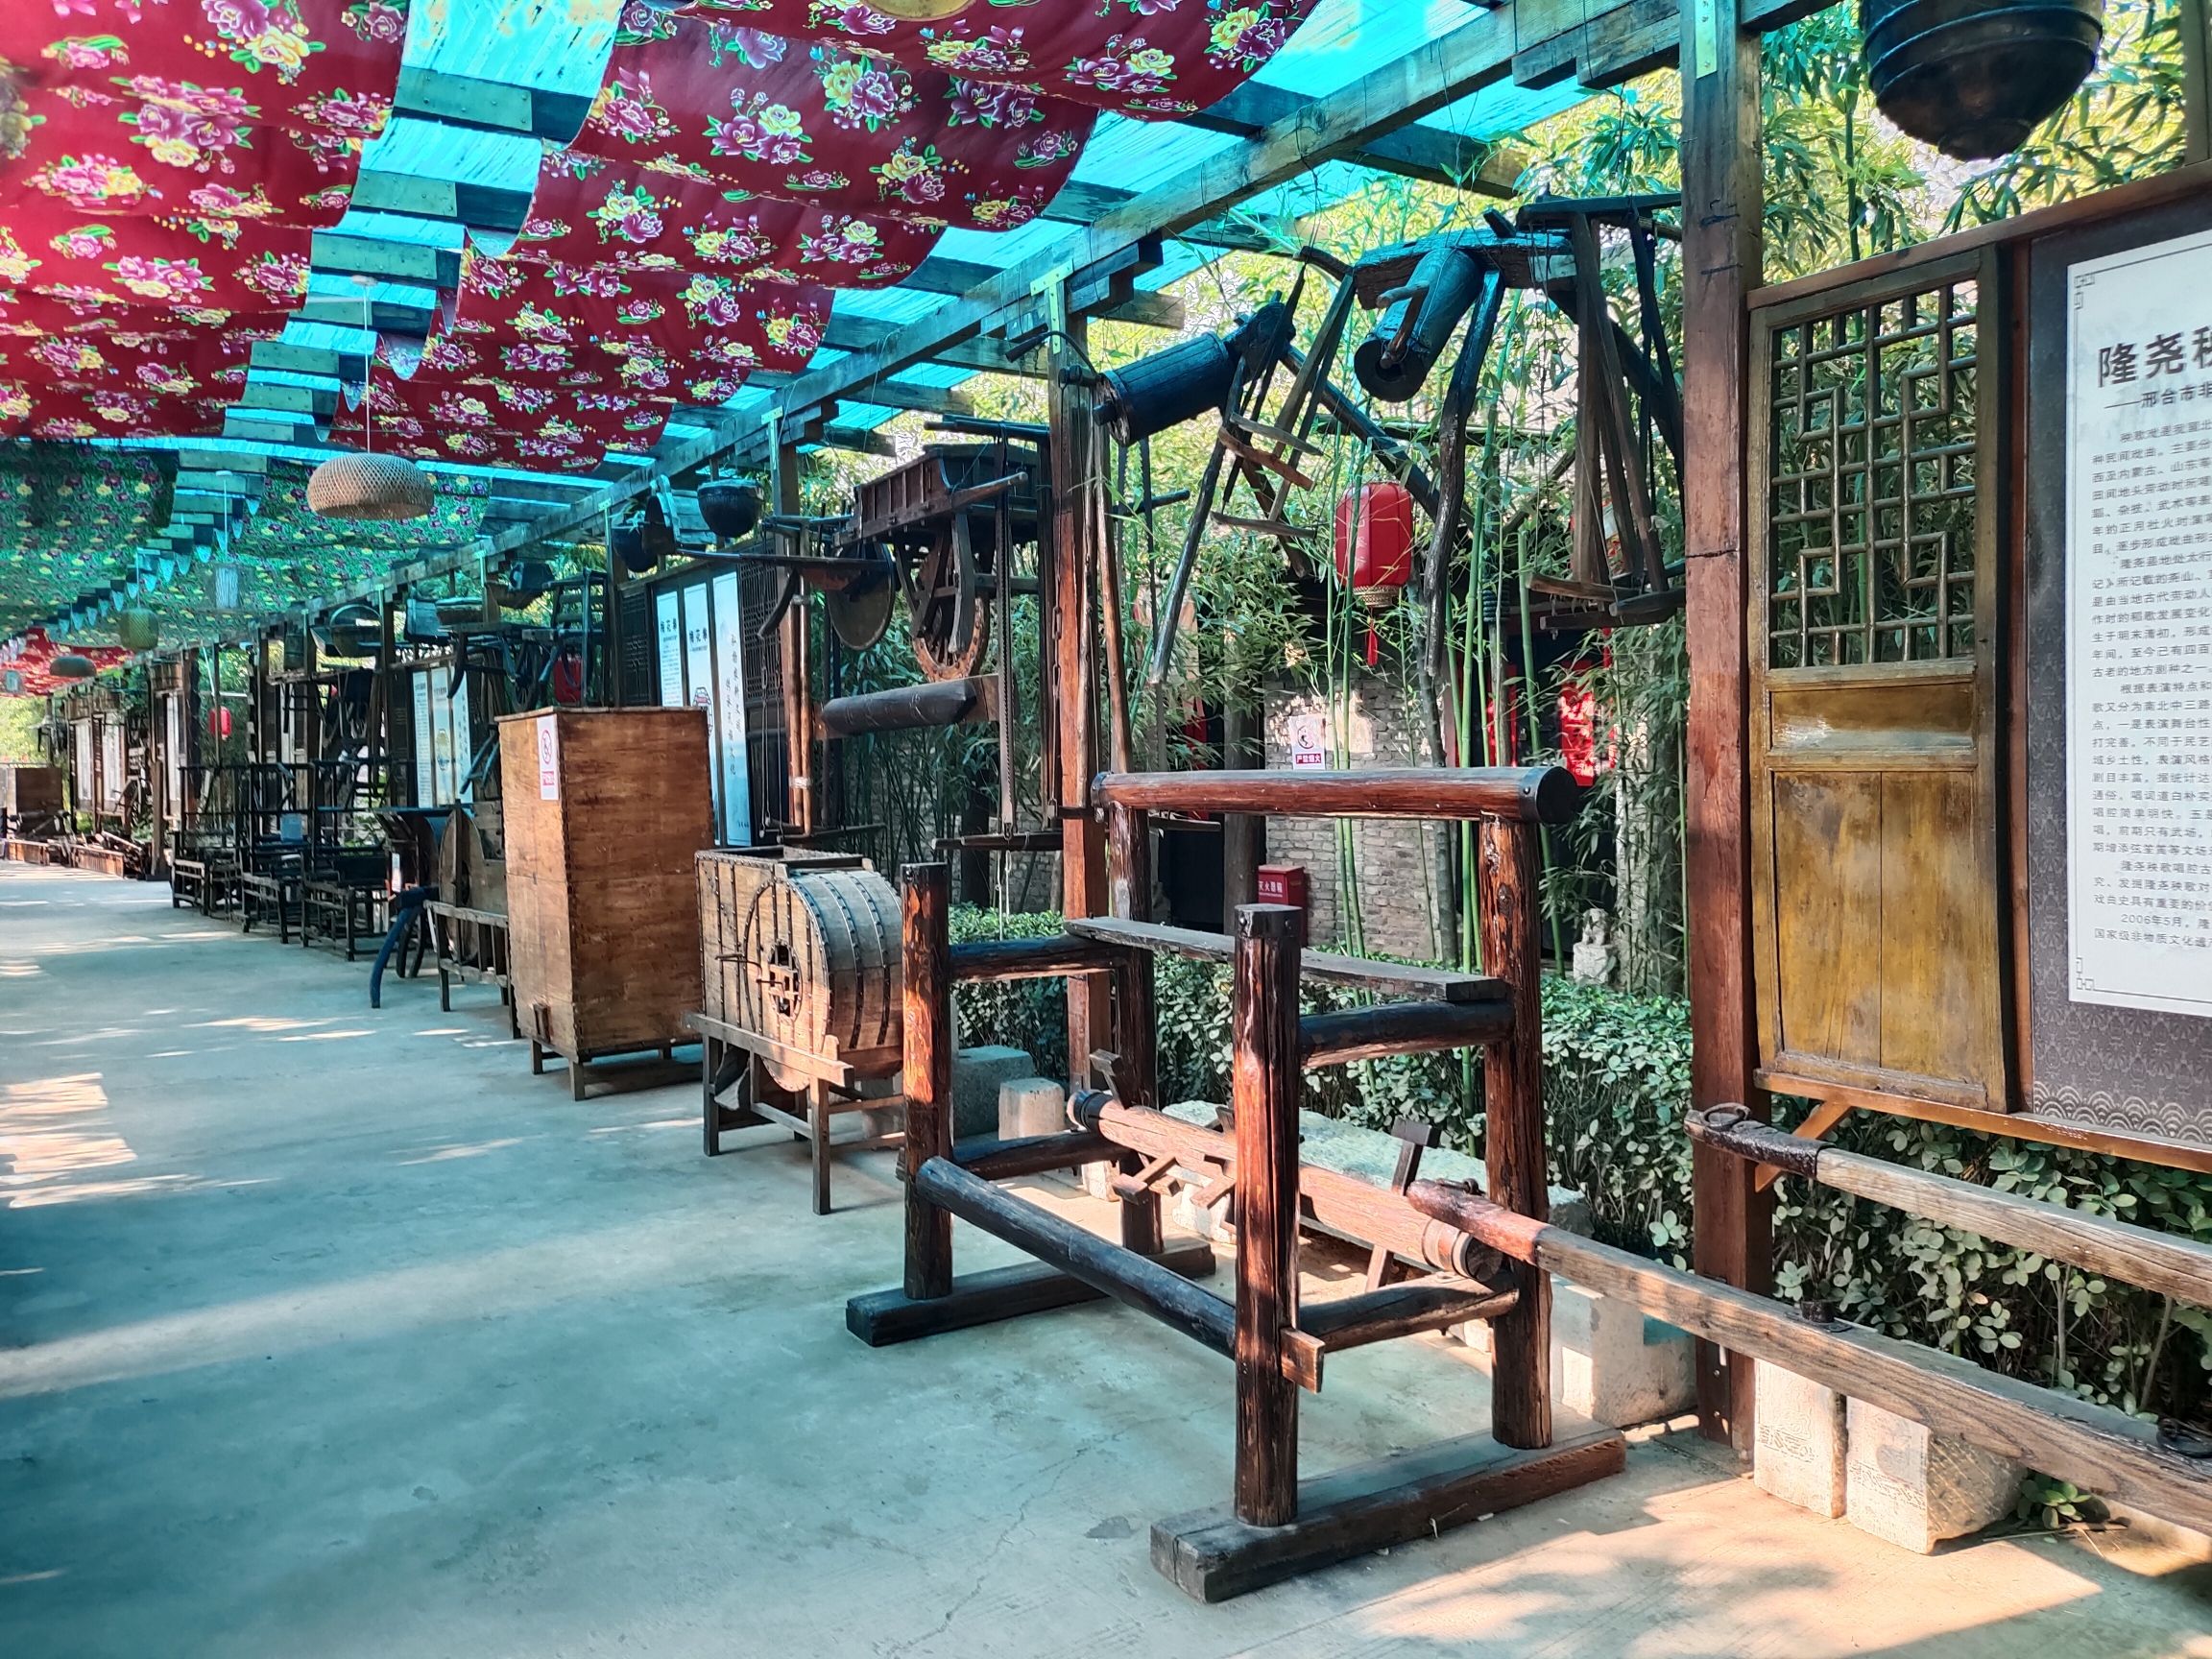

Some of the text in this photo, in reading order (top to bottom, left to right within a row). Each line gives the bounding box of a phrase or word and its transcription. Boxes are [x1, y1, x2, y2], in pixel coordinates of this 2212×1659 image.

[2092, 532, 2212, 554] 目，逐步形成戏曲形
